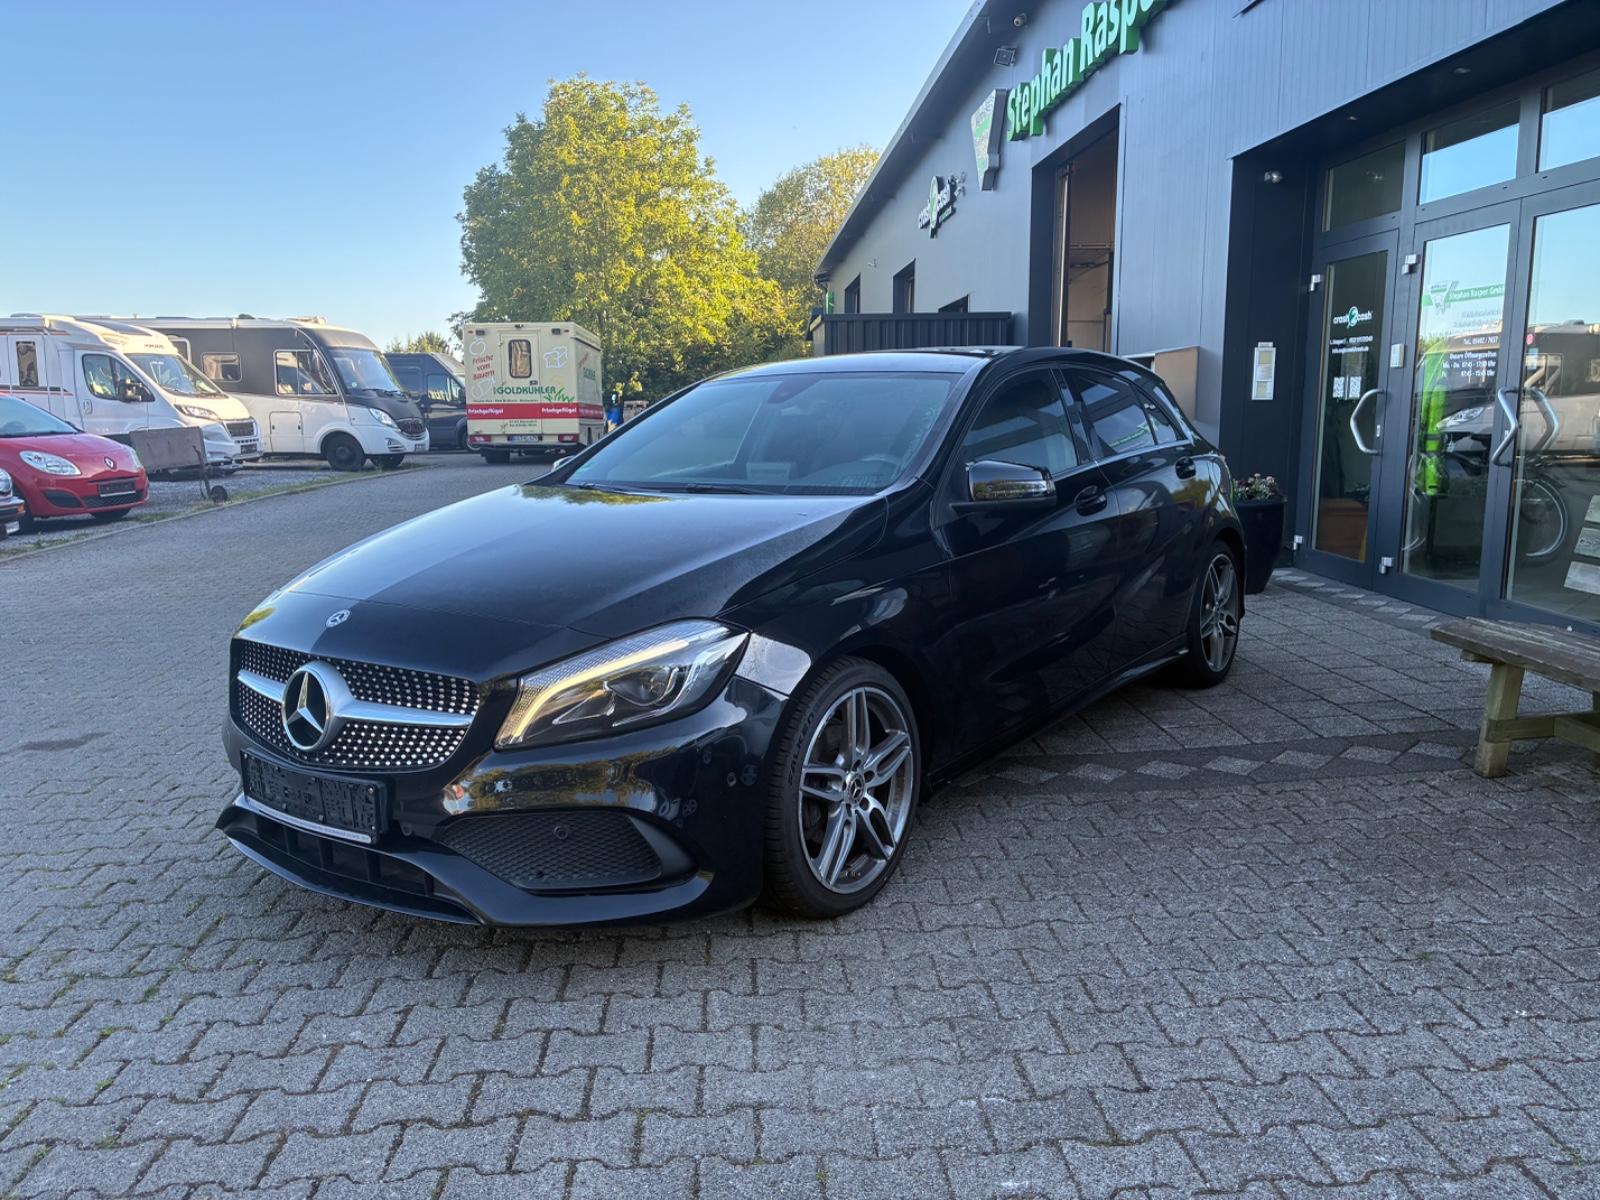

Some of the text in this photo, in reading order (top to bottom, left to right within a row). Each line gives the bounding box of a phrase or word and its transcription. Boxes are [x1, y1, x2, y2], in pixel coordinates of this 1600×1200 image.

[1007, 38, 1076, 141] Stephan
[1080, 0, 1155, 72] Rasp
[476, 363, 491, 371] vom
